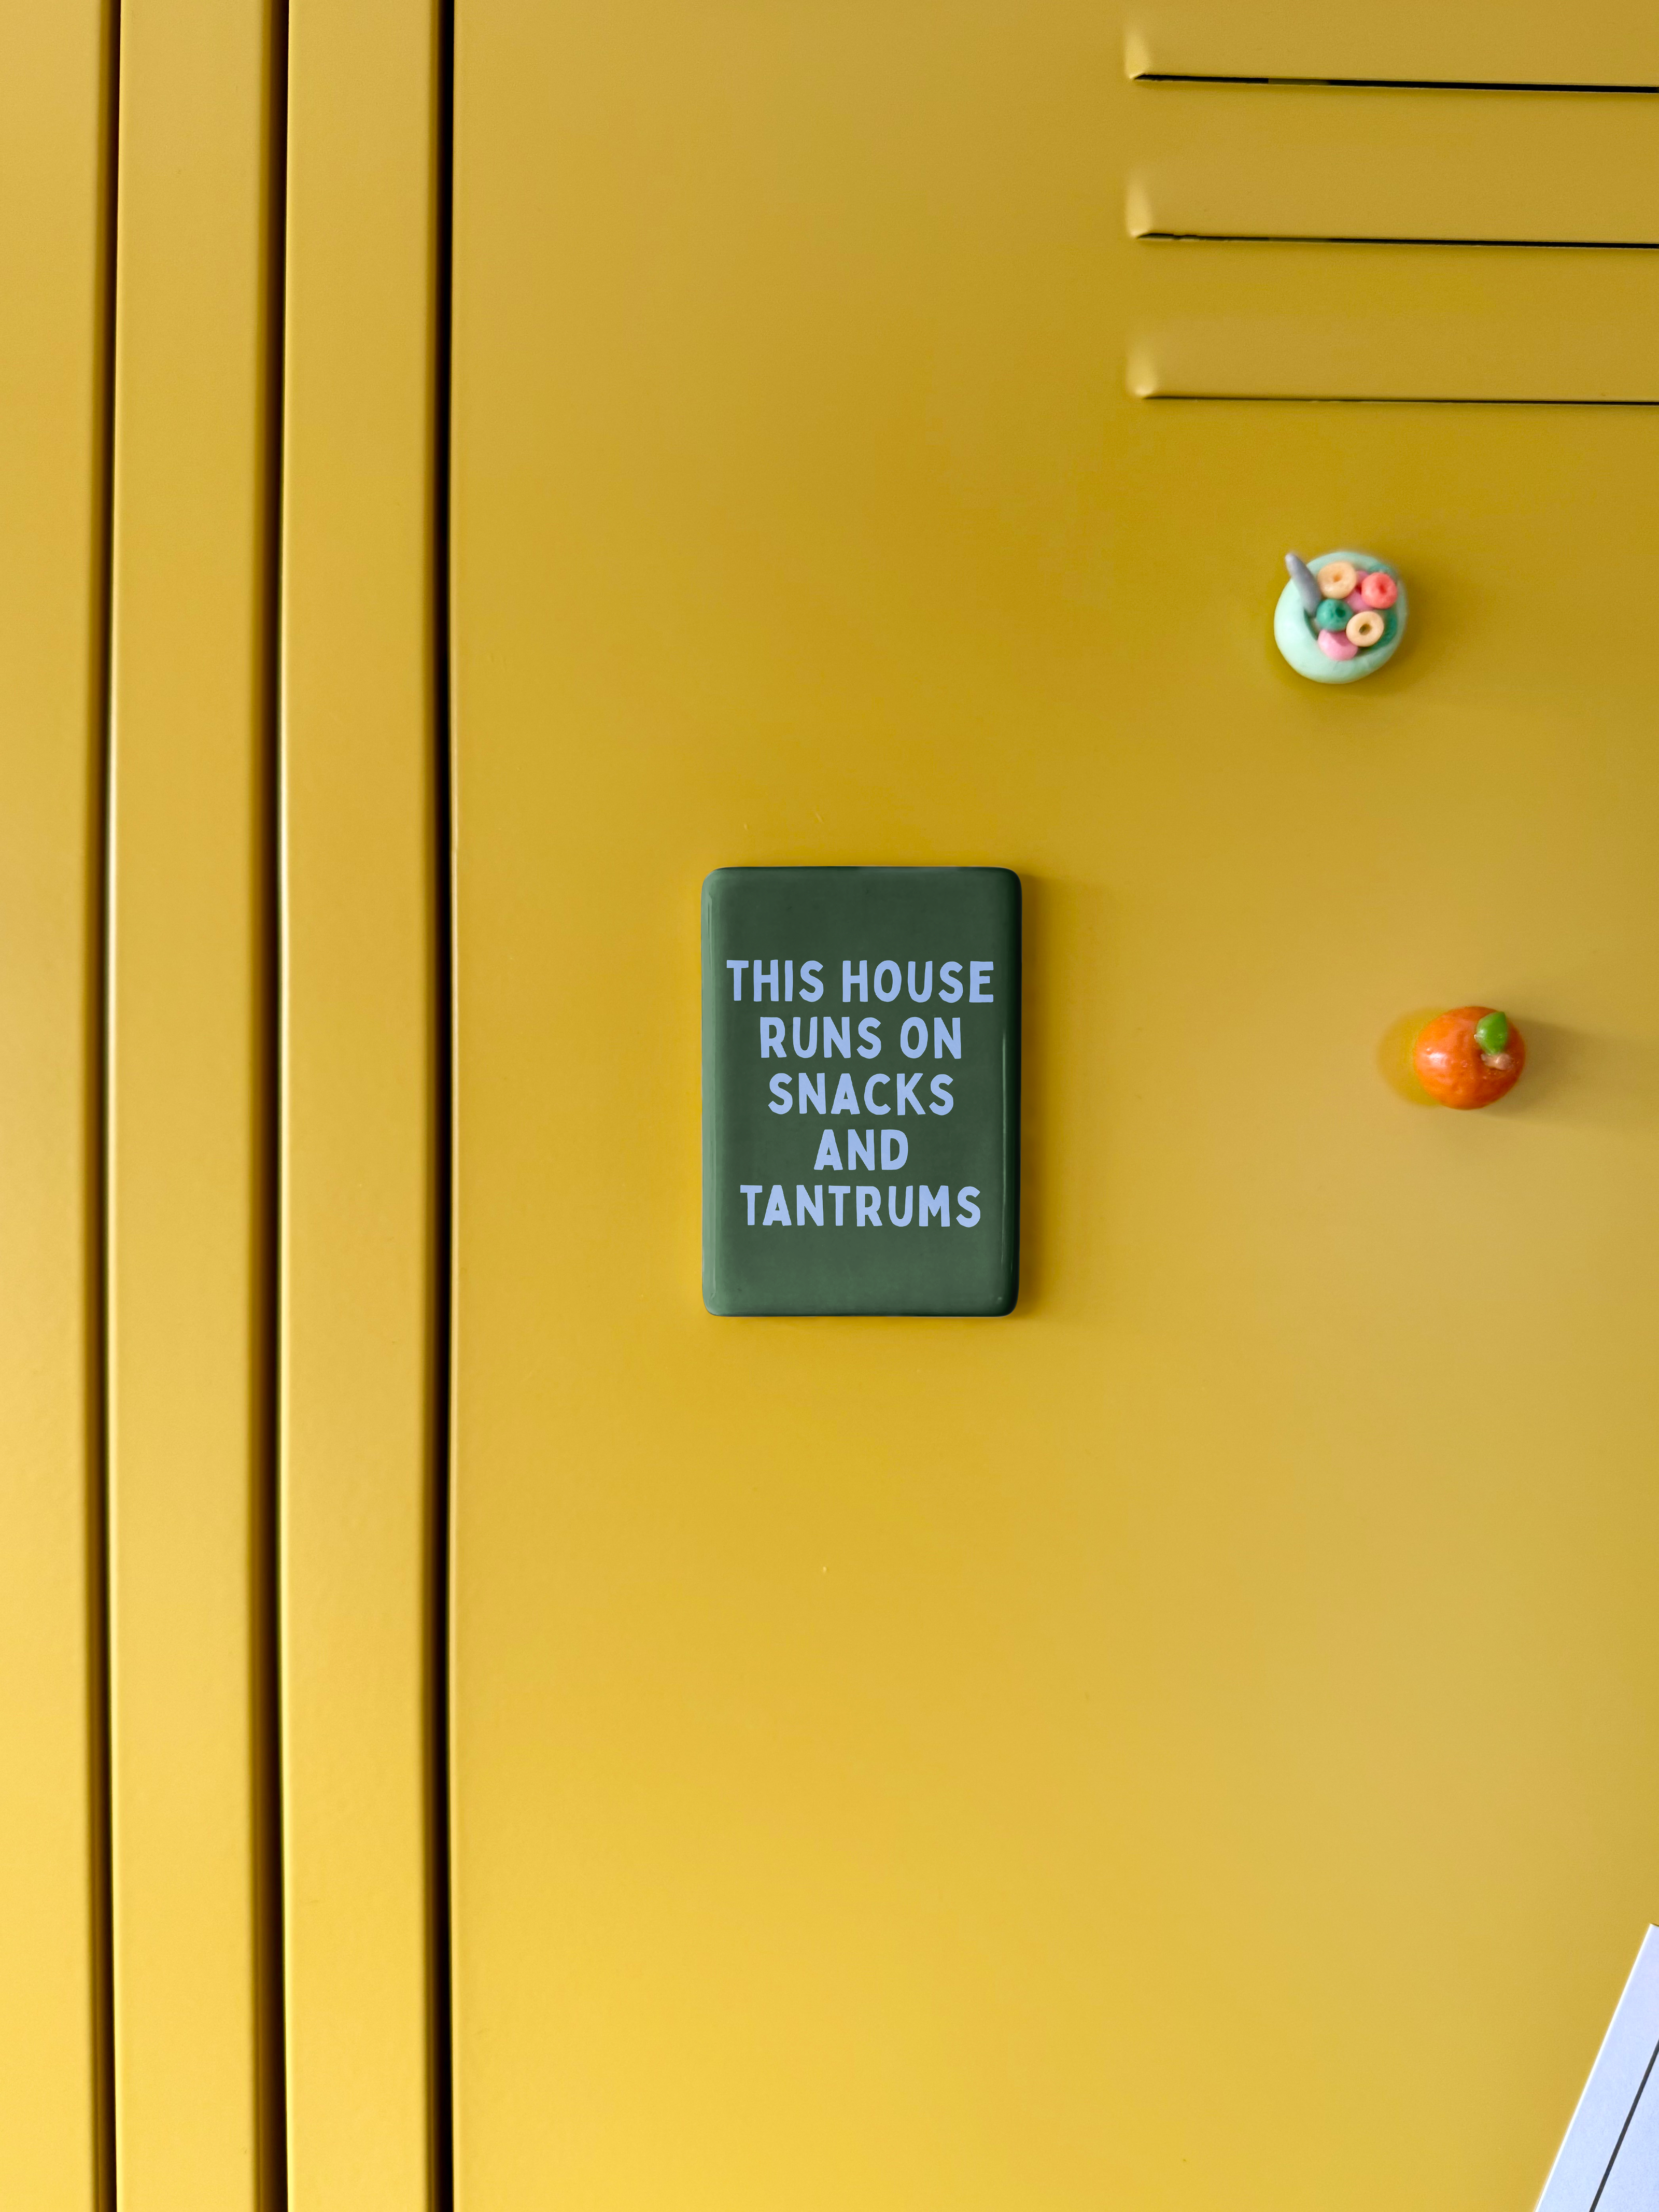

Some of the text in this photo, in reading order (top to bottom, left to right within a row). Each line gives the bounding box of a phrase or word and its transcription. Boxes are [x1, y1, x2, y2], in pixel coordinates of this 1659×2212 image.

[726, 959, 994, 1003] THIS HOUSE
[760, 1016, 961, 1059] RUNS ON
[768, 1073, 954, 1116] SNACKS
[813, 1129, 908, 1171] AND
[740, 1185, 981, 1228] TANTRUMS
